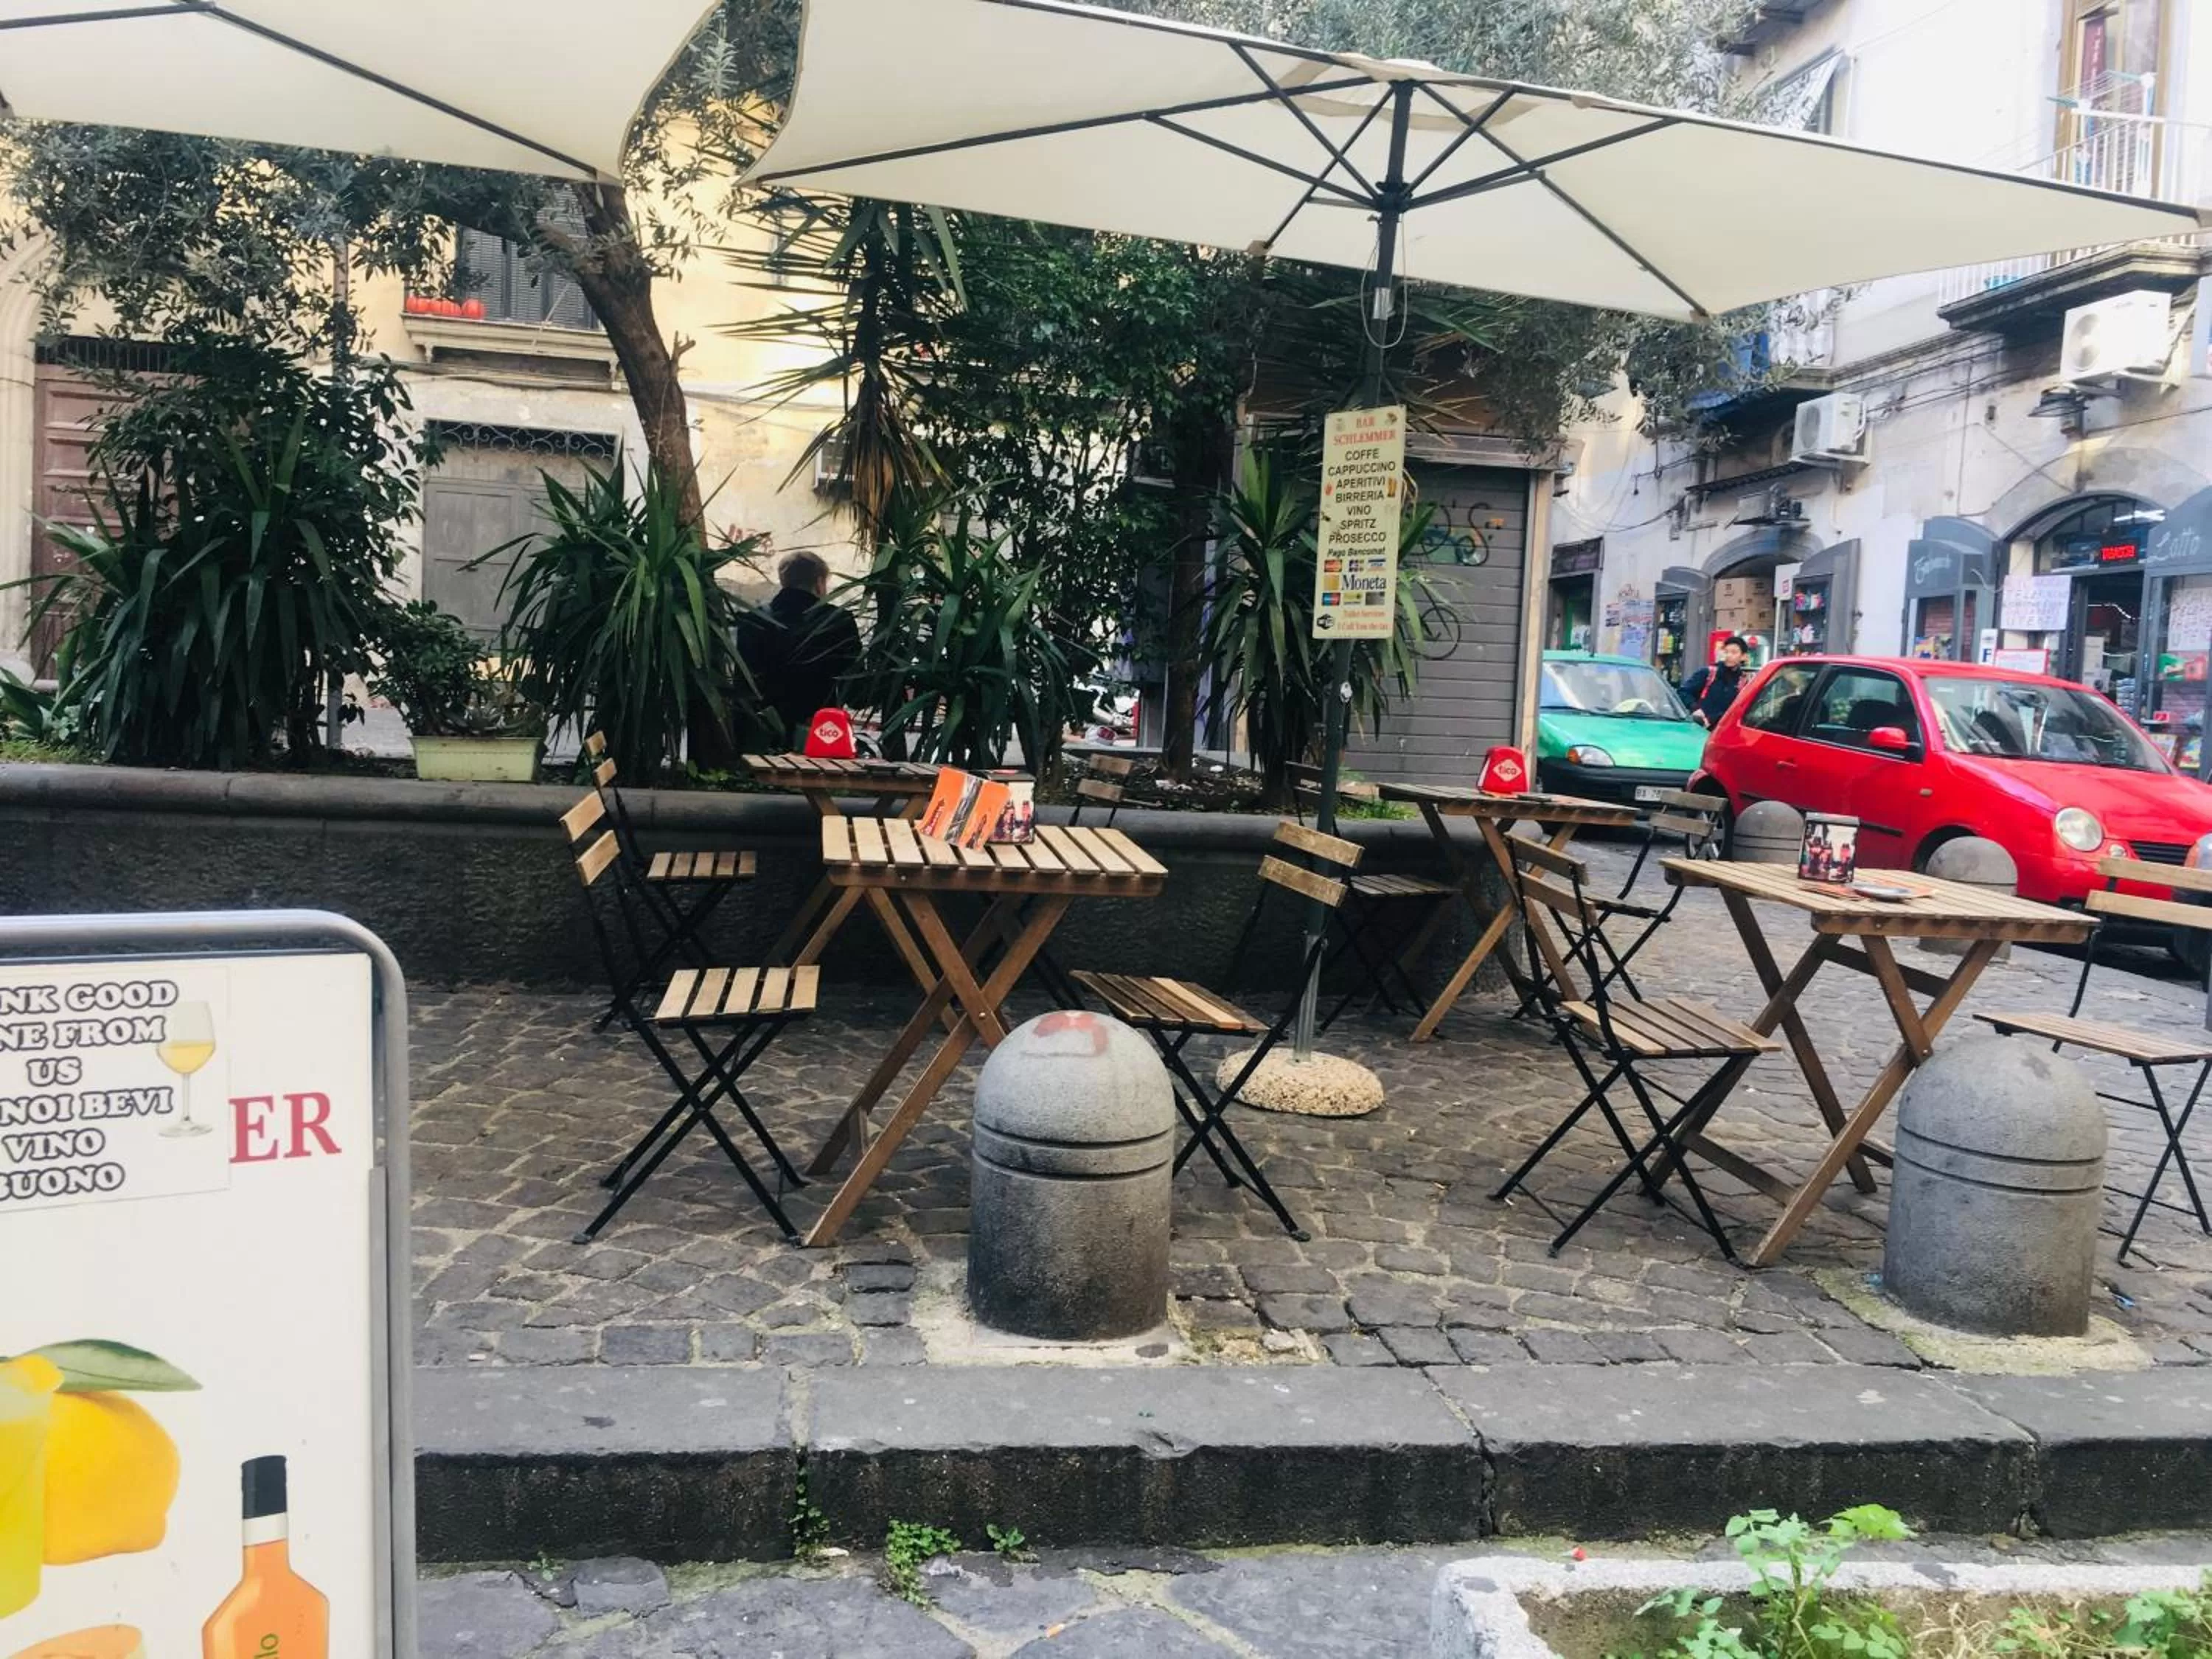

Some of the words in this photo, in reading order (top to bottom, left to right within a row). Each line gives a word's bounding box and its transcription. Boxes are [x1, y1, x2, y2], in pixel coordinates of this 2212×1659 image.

[1357, 416, 1375, 428] BAR
[1333, 429, 1396, 445] SCHLEMMER
[1345, 448, 1380, 461] COFFE
[1328, 461, 1396, 476] CAPPUCCINO
[1336, 476, 1385, 489] APERITIVI
[1335, 490, 1384, 503] BIRRERIA
[1346, 505, 1371, 515] VINO
[1340, 518, 1377, 530] SPRITZ
[1329, 532, 1386, 544] PROSECCO
[1342, 574, 1387, 591] Moneta
[819, 728, 839, 738] tico
[0, 984, 60, 1015] NK
[65, 981, 178, 1012] GOOD
[52, 1015, 166, 1049] FROM
[26, 1055, 83, 1087] US
[0, 1093, 74, 1127] NOI
[80, 1087, 174, 1120] BEVI
[228, 1091, 342, 1164] ER
[1, 1127, 106, 1164] VINO
